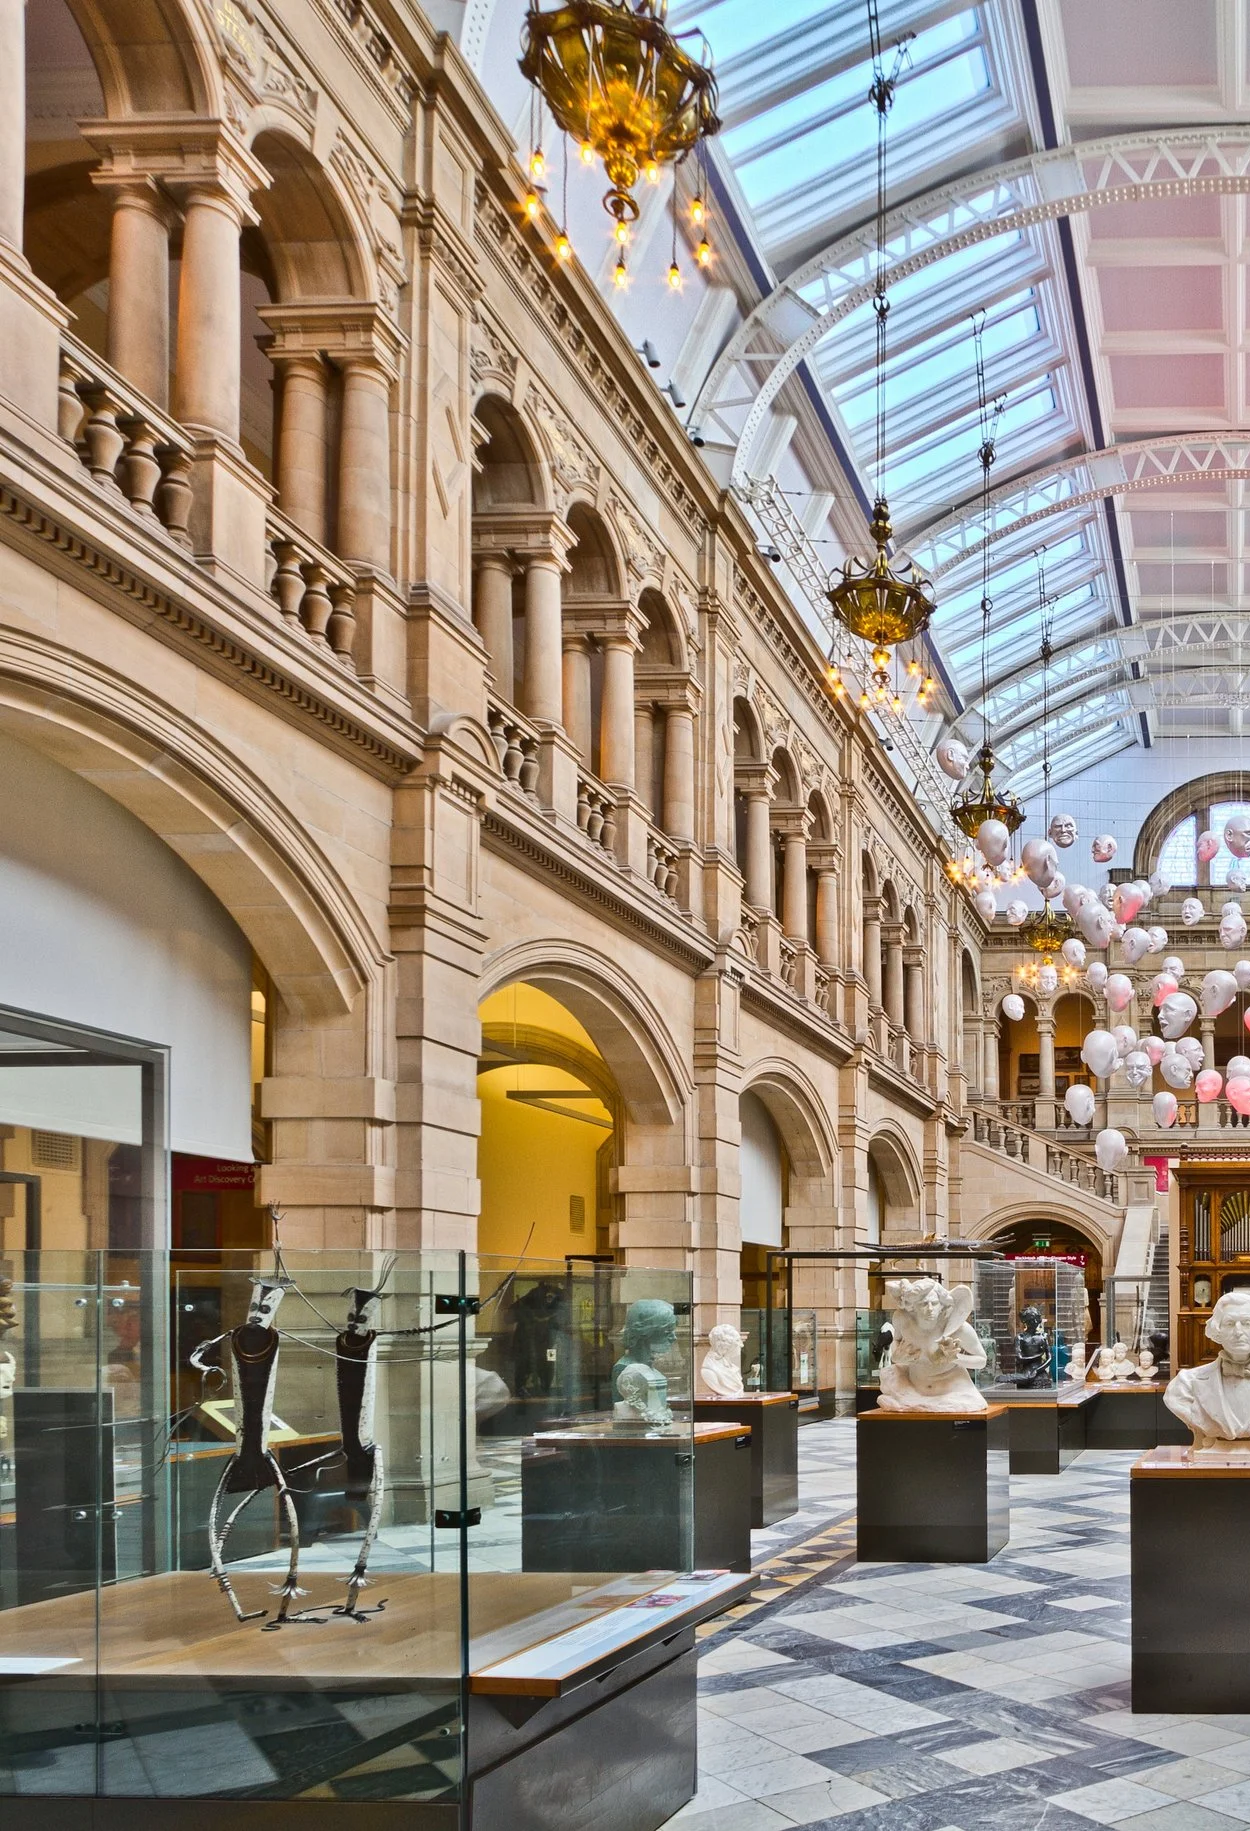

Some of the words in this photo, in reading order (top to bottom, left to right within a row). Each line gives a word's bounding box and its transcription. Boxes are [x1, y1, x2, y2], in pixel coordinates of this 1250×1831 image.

[216, 1164, 248, 1173] Looking
[194, 1175, 207, 1183] Art
[208, 1175, 246, 1184] Discovery
